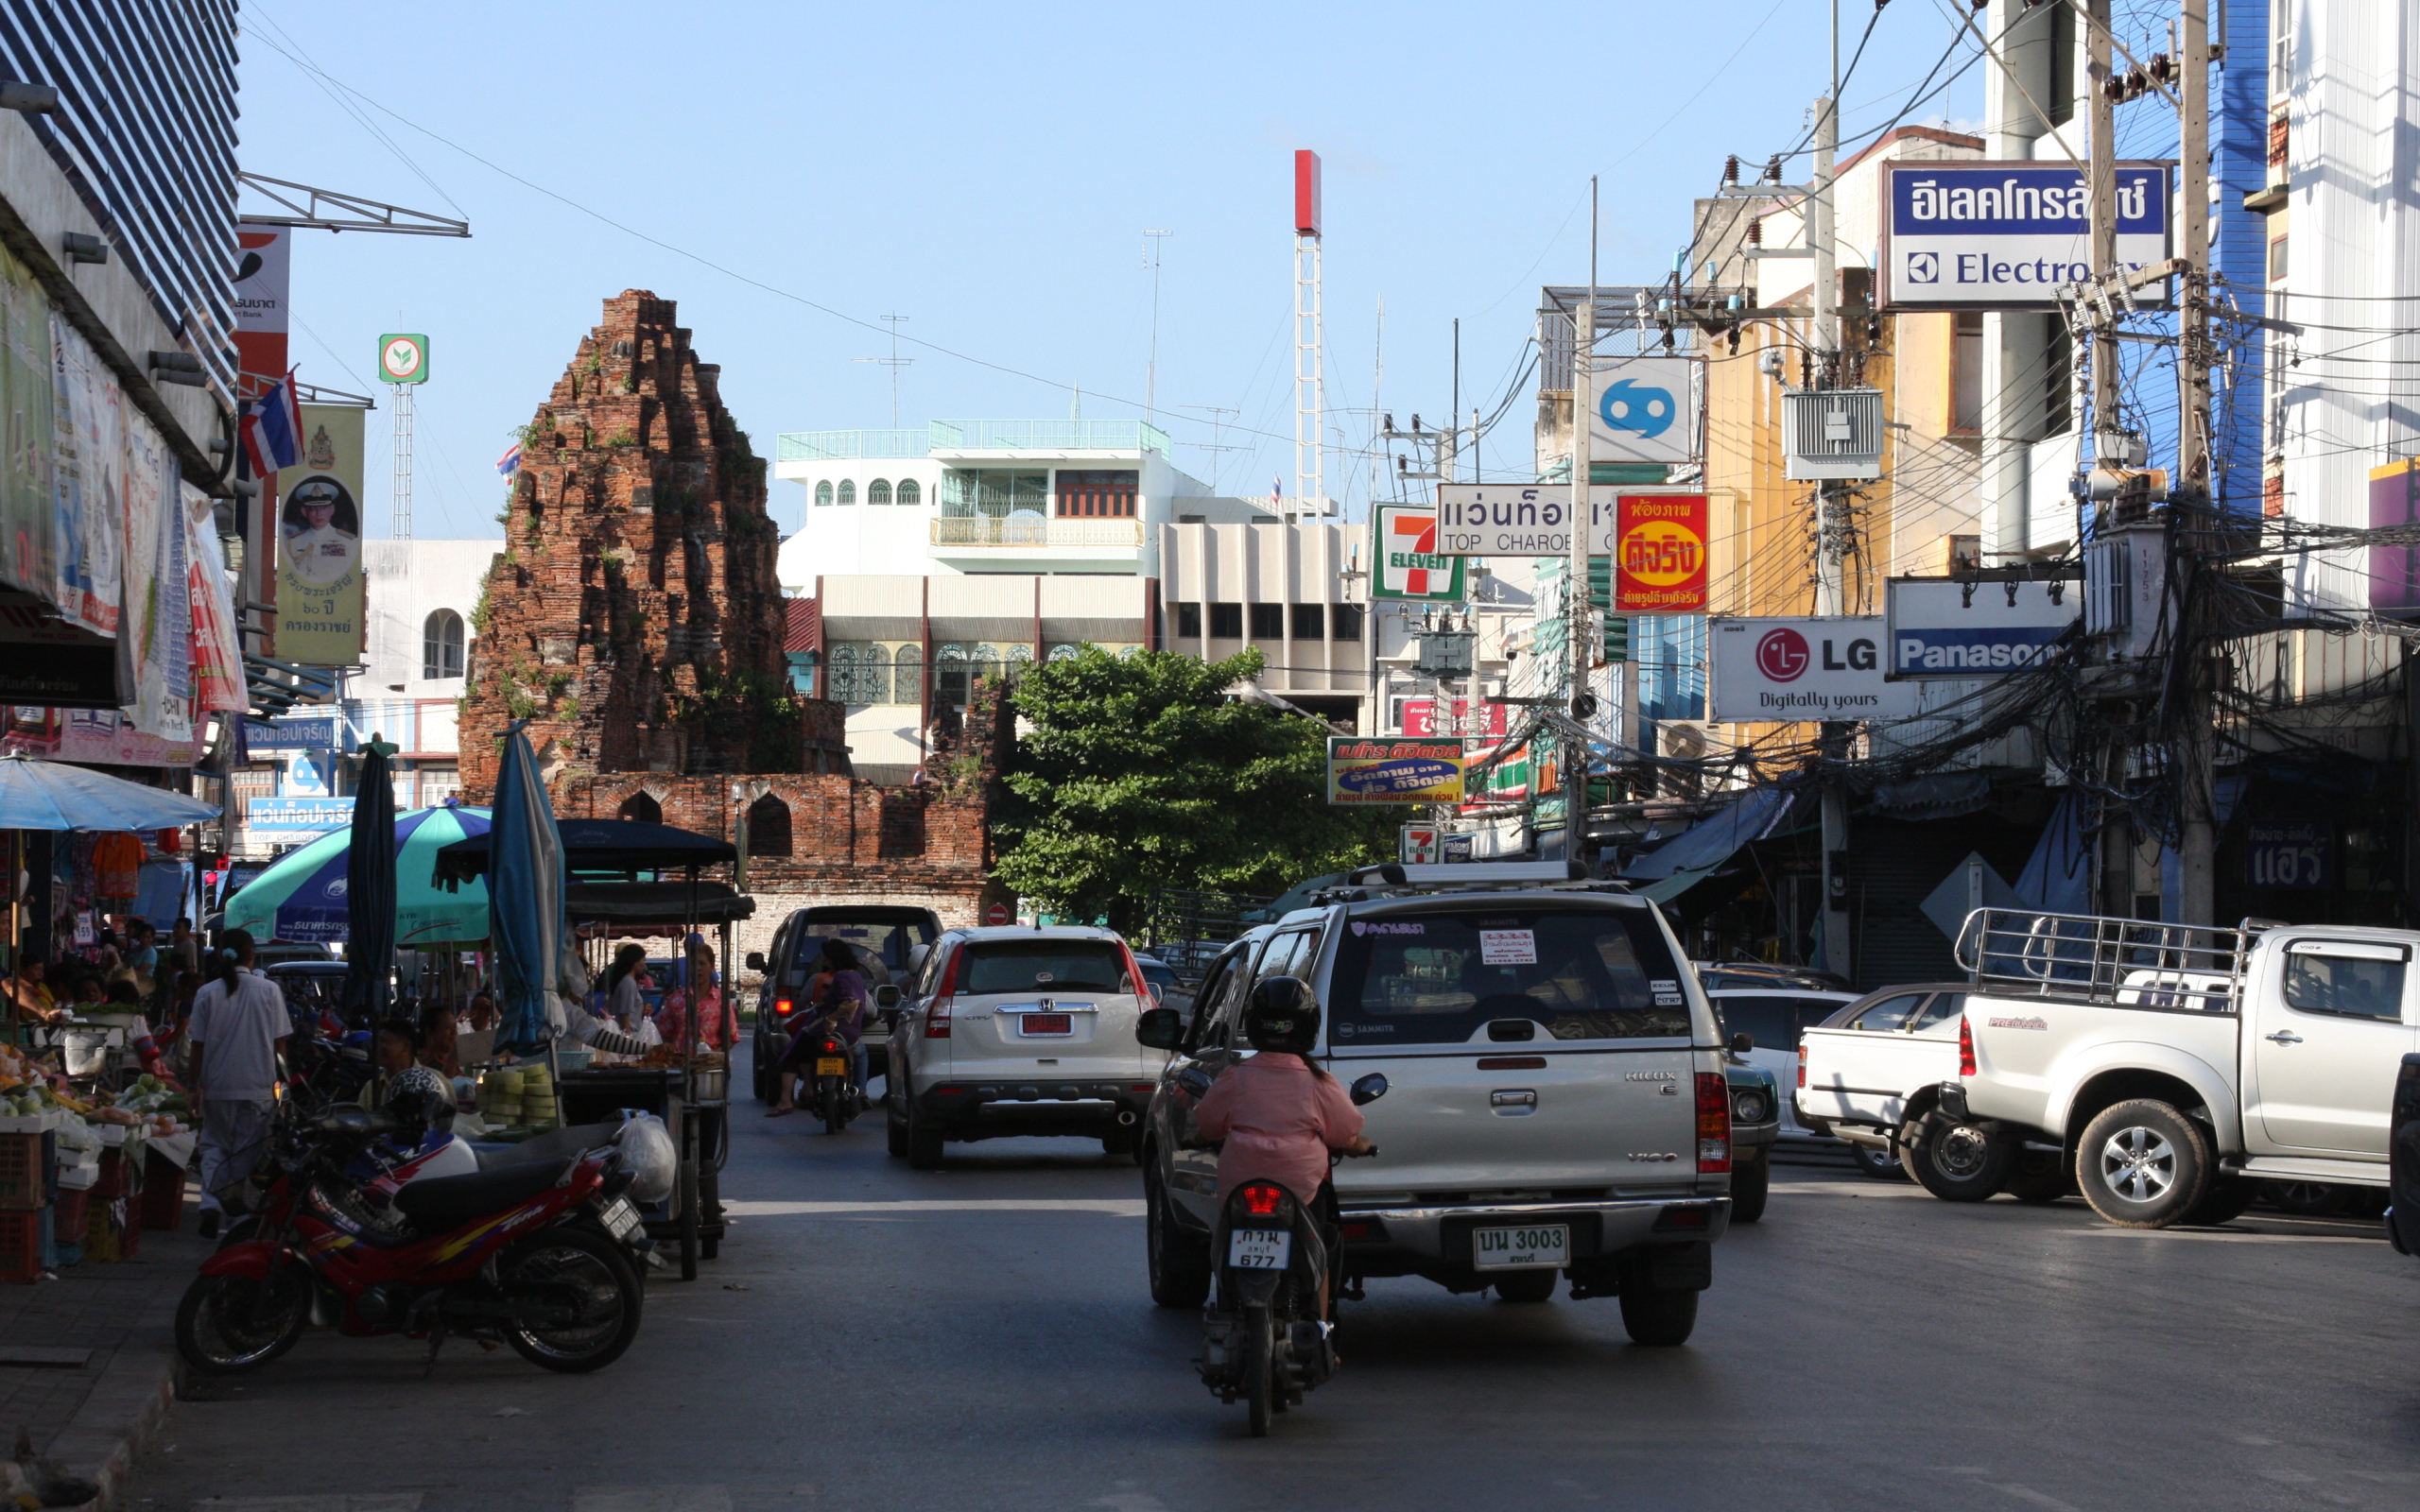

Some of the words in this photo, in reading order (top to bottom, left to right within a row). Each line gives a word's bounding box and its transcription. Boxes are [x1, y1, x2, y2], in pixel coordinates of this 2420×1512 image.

[1631, 499, 1691, 517] ห้องภาพ
[1445, 534, 1481, 550] TOP
[1392, 515, 1437, 595] 7
[1626, 532, 1697, 574] ดีจริง
[285, 573, 353, 596] ทรงพระเจริญ
[302, 603, 320, 613] ๖๐
[323, 599, 334, 614] ปี
[285, 618, 351, 633] ครองราชย์
[1823, 638, 1876, 671] LG
[1760, 692, 1828, 711] Digitally
[1834, 693, 1877, 710] yours
[1336, 741, 1388, 759] เมโทร
[1390, 743, 1461, 759] ดิจิตอล
[1418, 765, 1442, 773] จาก
[1393, 774, 1459, 789] ดิจิตอล
[1435, 791, 1453, 801] ด่วน
[1410, 831, 1433, 863] 7
[2255, 837, 2327, 885] แอร์
[399, 912, 417, 920] KTB
[1357, 1024, 1394, 1033] SAMMITR
[1989, 1018, 2048, 1029] PRERUNNER
[1625, 1072, 1676, 1081] HILUX
[1242, 1230, 1278, 1243] กวม
[1479, 1231, 1509, 1251] บน
[1516, 1229, 1562, 1249] 3003
[1240, 1255, 1275, 1267] 677
